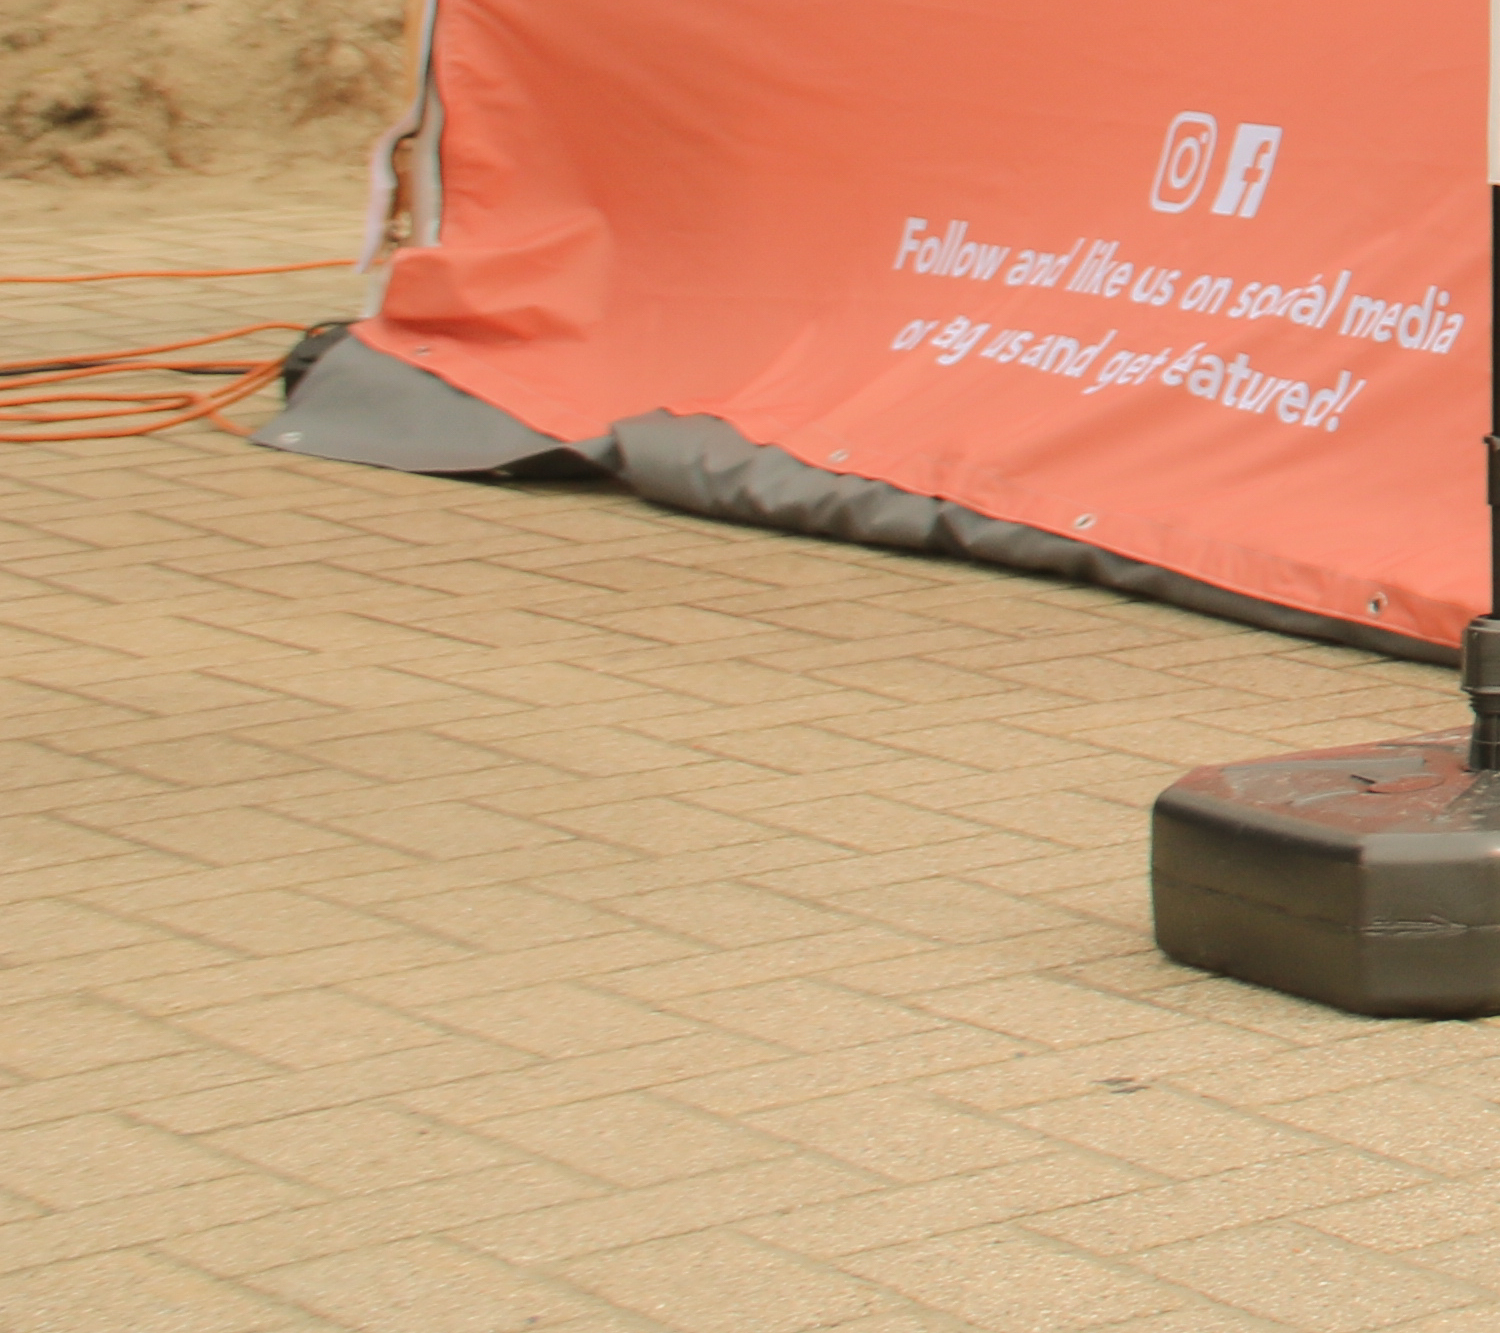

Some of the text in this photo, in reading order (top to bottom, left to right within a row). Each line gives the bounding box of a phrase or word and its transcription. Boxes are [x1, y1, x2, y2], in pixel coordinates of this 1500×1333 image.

[892, 217, 1011, 280] Follow
[1005, 237, 1087, 287] and
[1064, 239, 1135, 298] like
[1130, 266, 1182, 306] us
[1179, 275, 1233, 314] on
[1339, 285, 1465, 354] media
[890, 319, 940, 350] or
[931, 316, 991, 365] ag
[980, 329, 1034, 363] us
[1019, 329, 1118, 378] and
[1081, 347, 1173, 395] get
